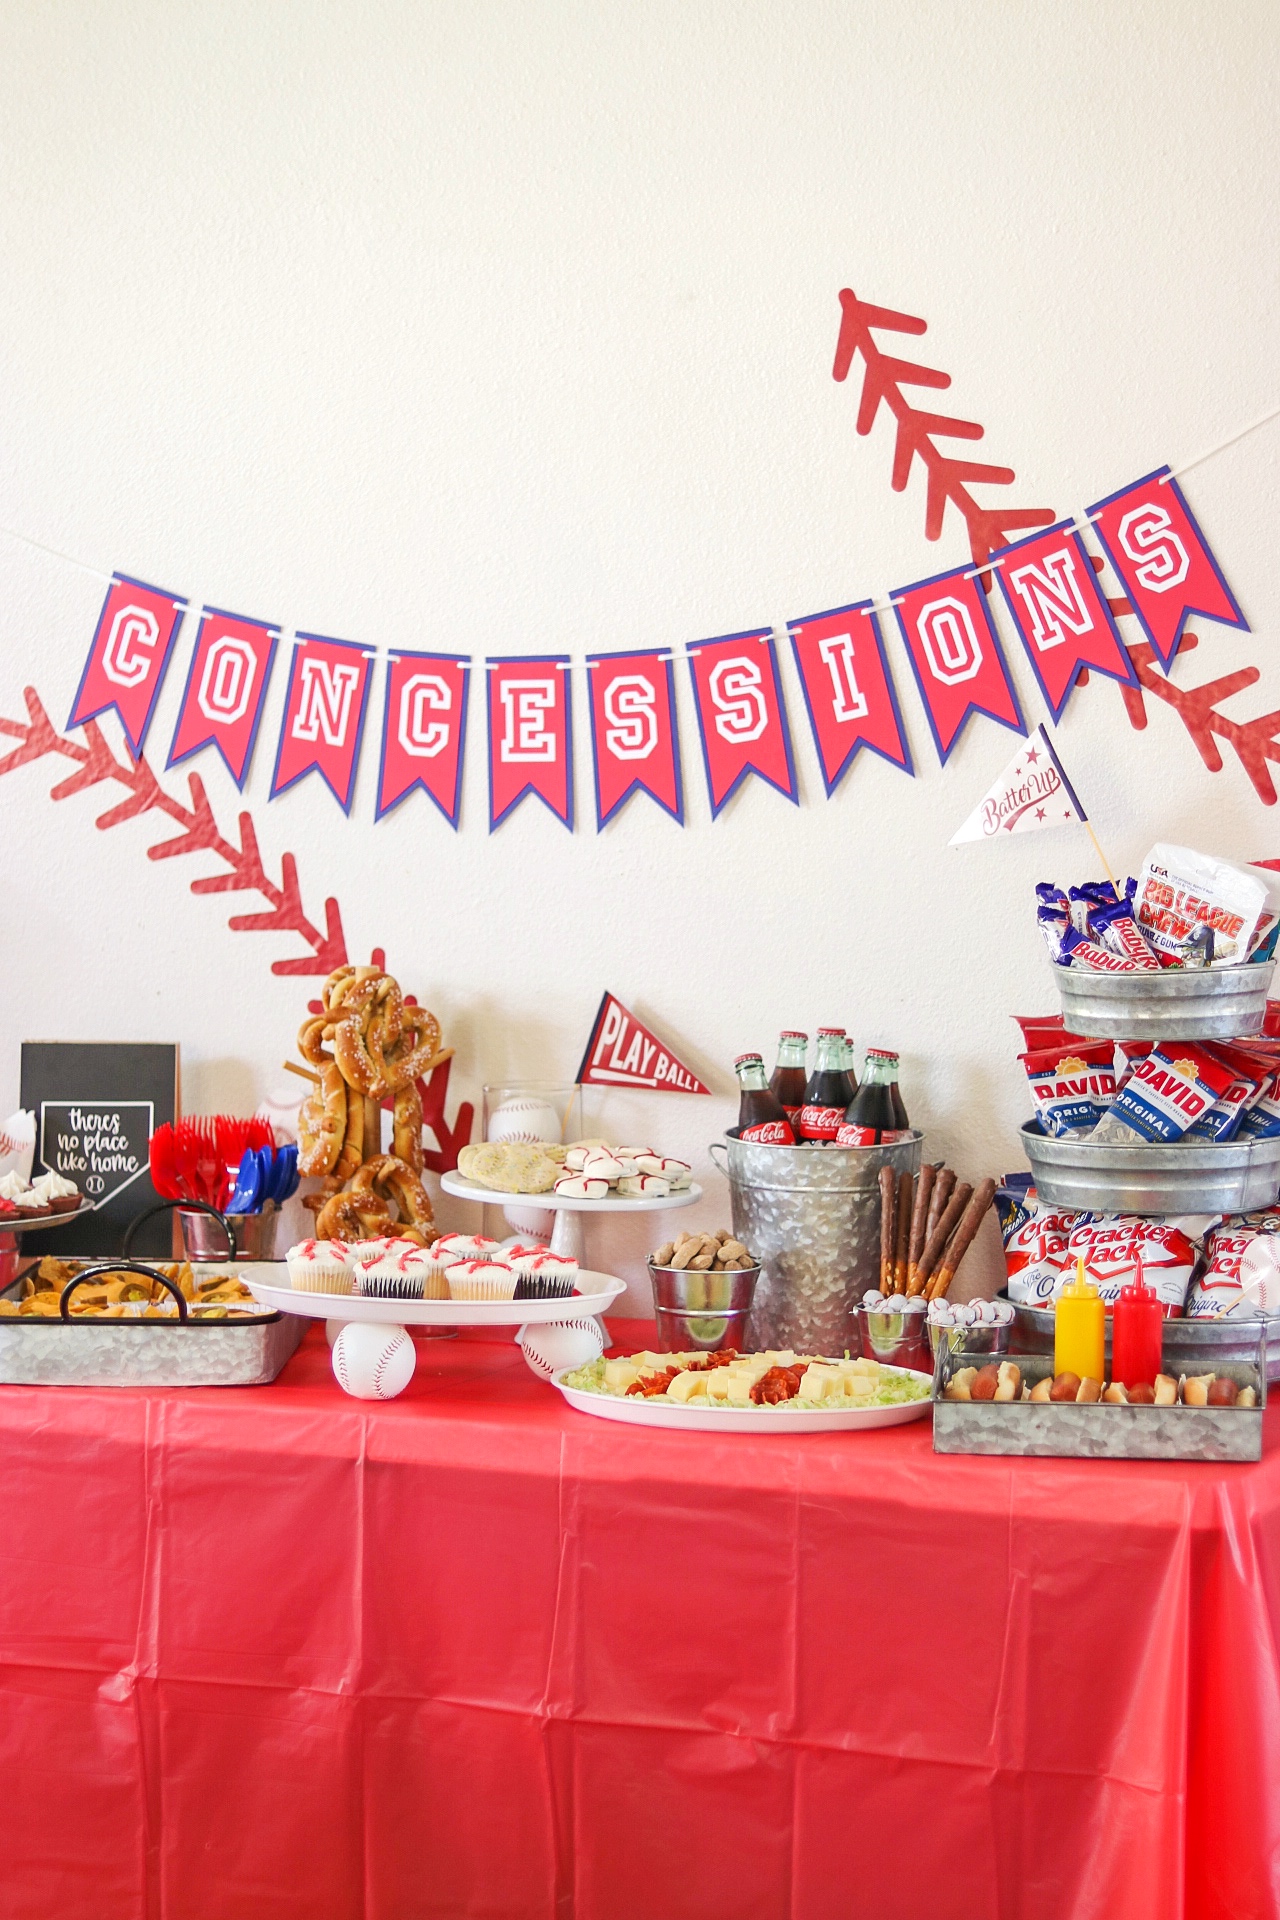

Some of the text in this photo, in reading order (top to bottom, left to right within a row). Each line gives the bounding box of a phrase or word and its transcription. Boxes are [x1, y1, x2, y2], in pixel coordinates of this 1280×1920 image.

[102, 502, 1190, 762] CONCESSIONS
[981, 784, 1031, 836] Batter
[1139, 901, 1195, 941] CHEW
[1142, 877, 1175, 909] BIG
[1174, 890, 1246, 939] LEAGUE
[1160, 938, 1178, 951] GUM
[592, 1001, 656, 1074] PLAY
[1034, 1074, 1116, 1100] DAVID
[1134, 1060, 1205, 1117] DAVID
[68, 1108, 120, 1135] theres
[1117, 1093, 1170, 1137] ORIGINAL
[58, 1131, 129, 1157] no place
[57, 1152, 139, 1173] like home
[1070, 1220, 1172, 1248] Cracker
[1071, 1241, 1145, 1269] Jack
